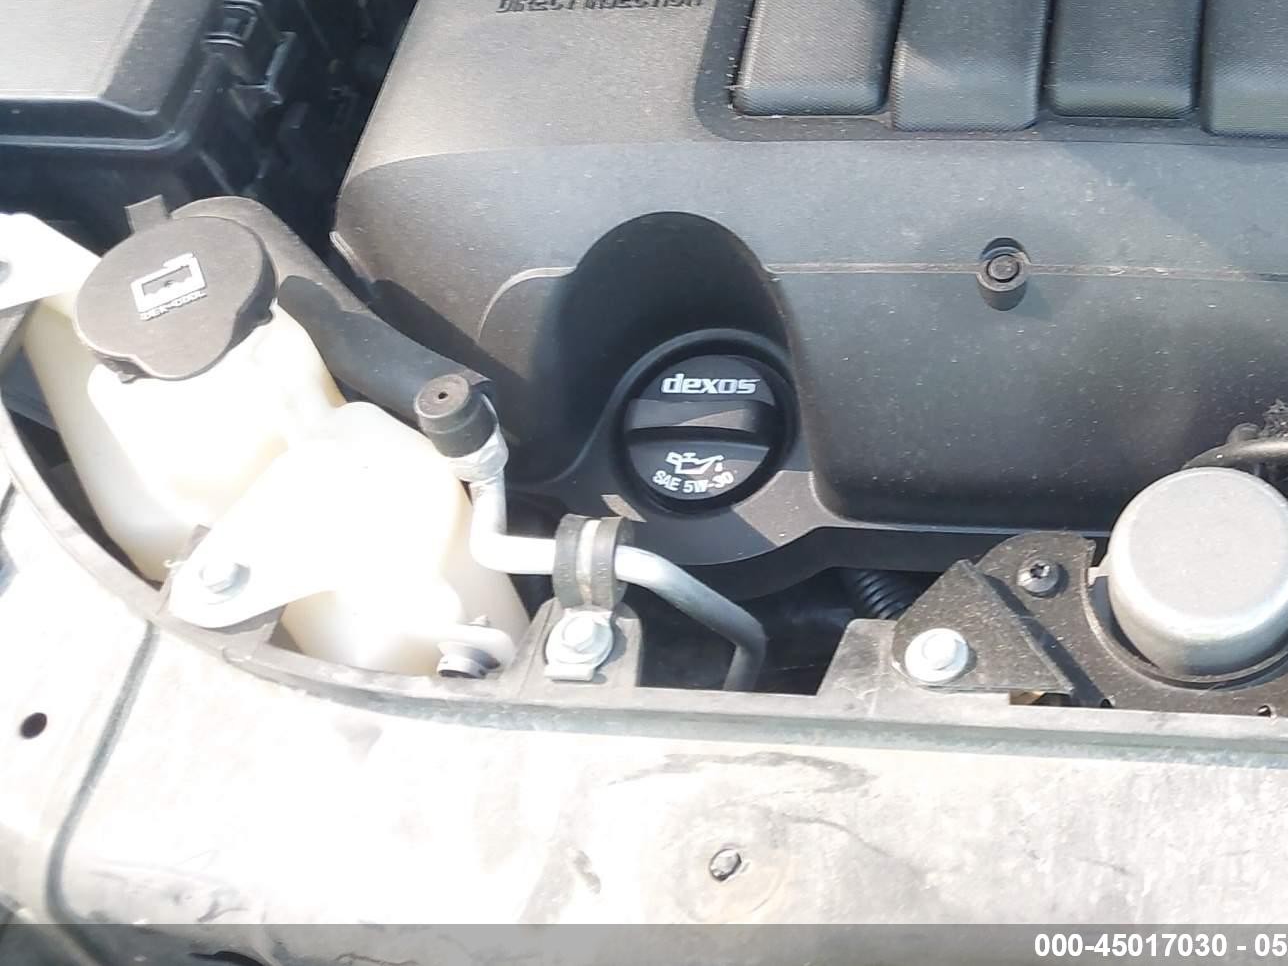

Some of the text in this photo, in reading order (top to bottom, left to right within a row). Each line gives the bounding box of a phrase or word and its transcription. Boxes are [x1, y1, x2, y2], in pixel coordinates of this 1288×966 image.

[661, 373, 761, 394] dexos
[652, 470, 735, 494] SAE 5W-30
